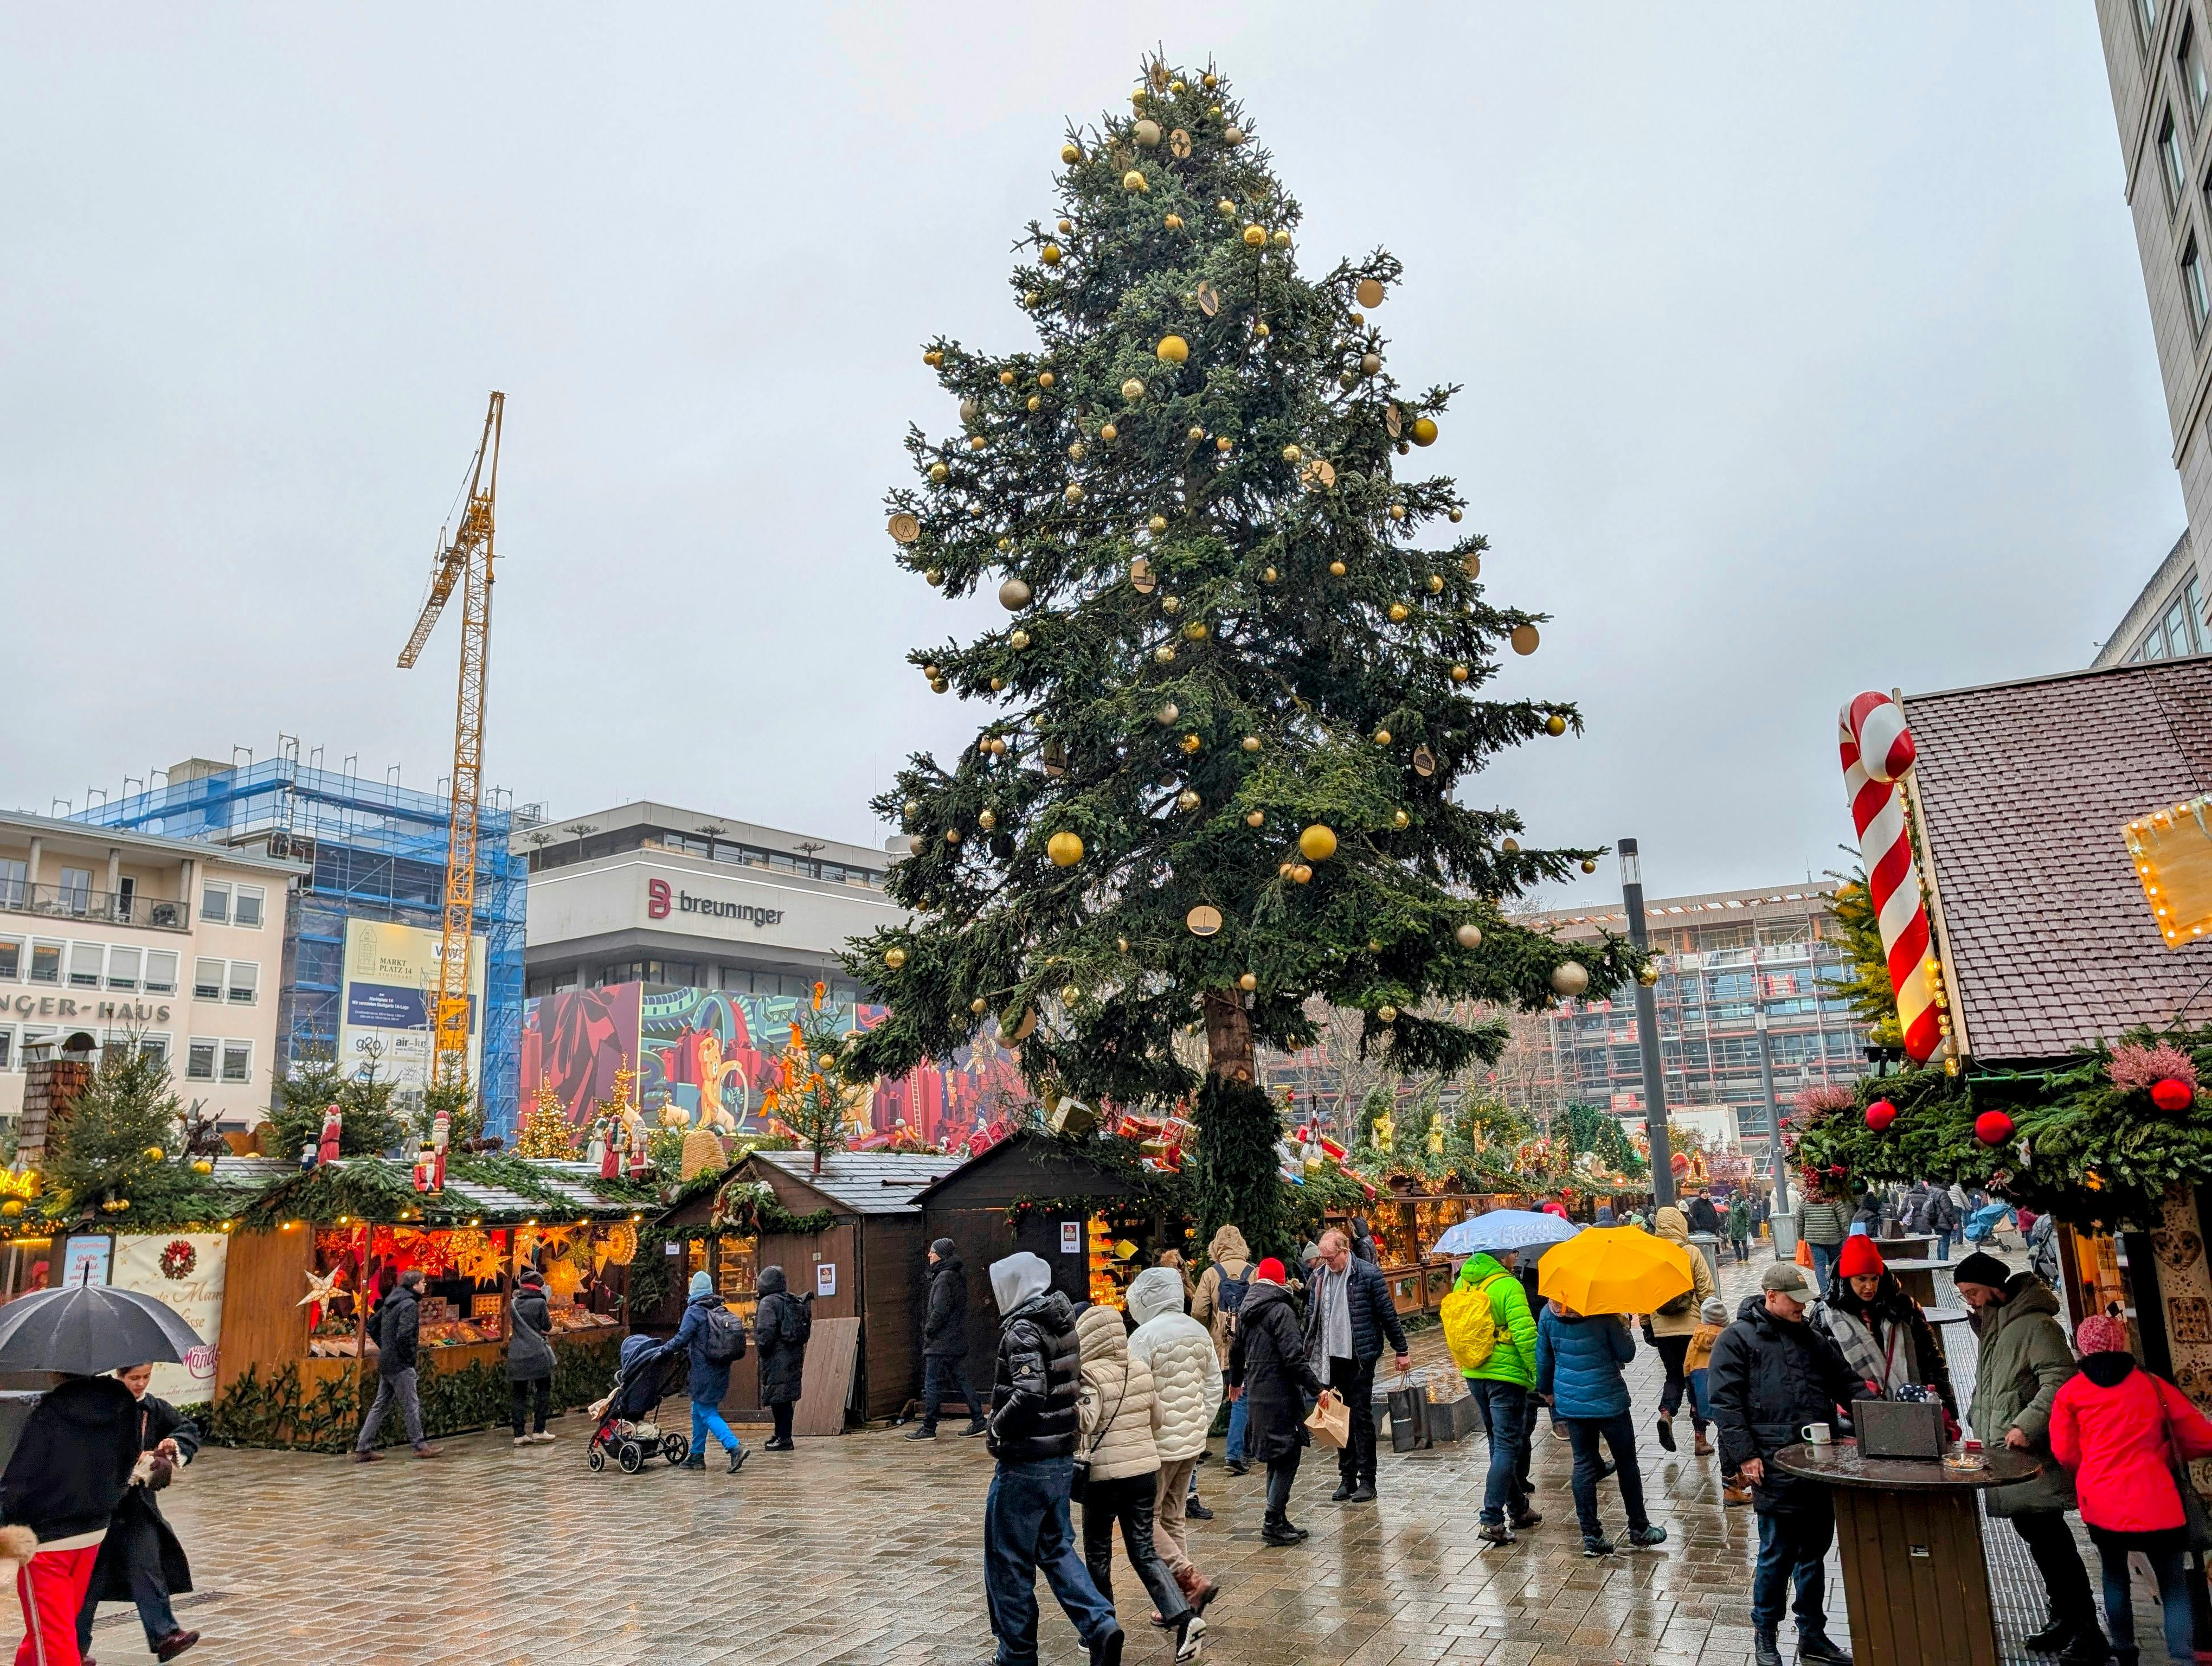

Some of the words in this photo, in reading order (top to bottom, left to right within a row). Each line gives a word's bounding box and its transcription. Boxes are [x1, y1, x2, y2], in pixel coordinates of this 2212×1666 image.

[680, 890, 786, 927] breuninger
[380, 957, 407, 966] MARKT
[380, 964, 403, 974] PLATZ
